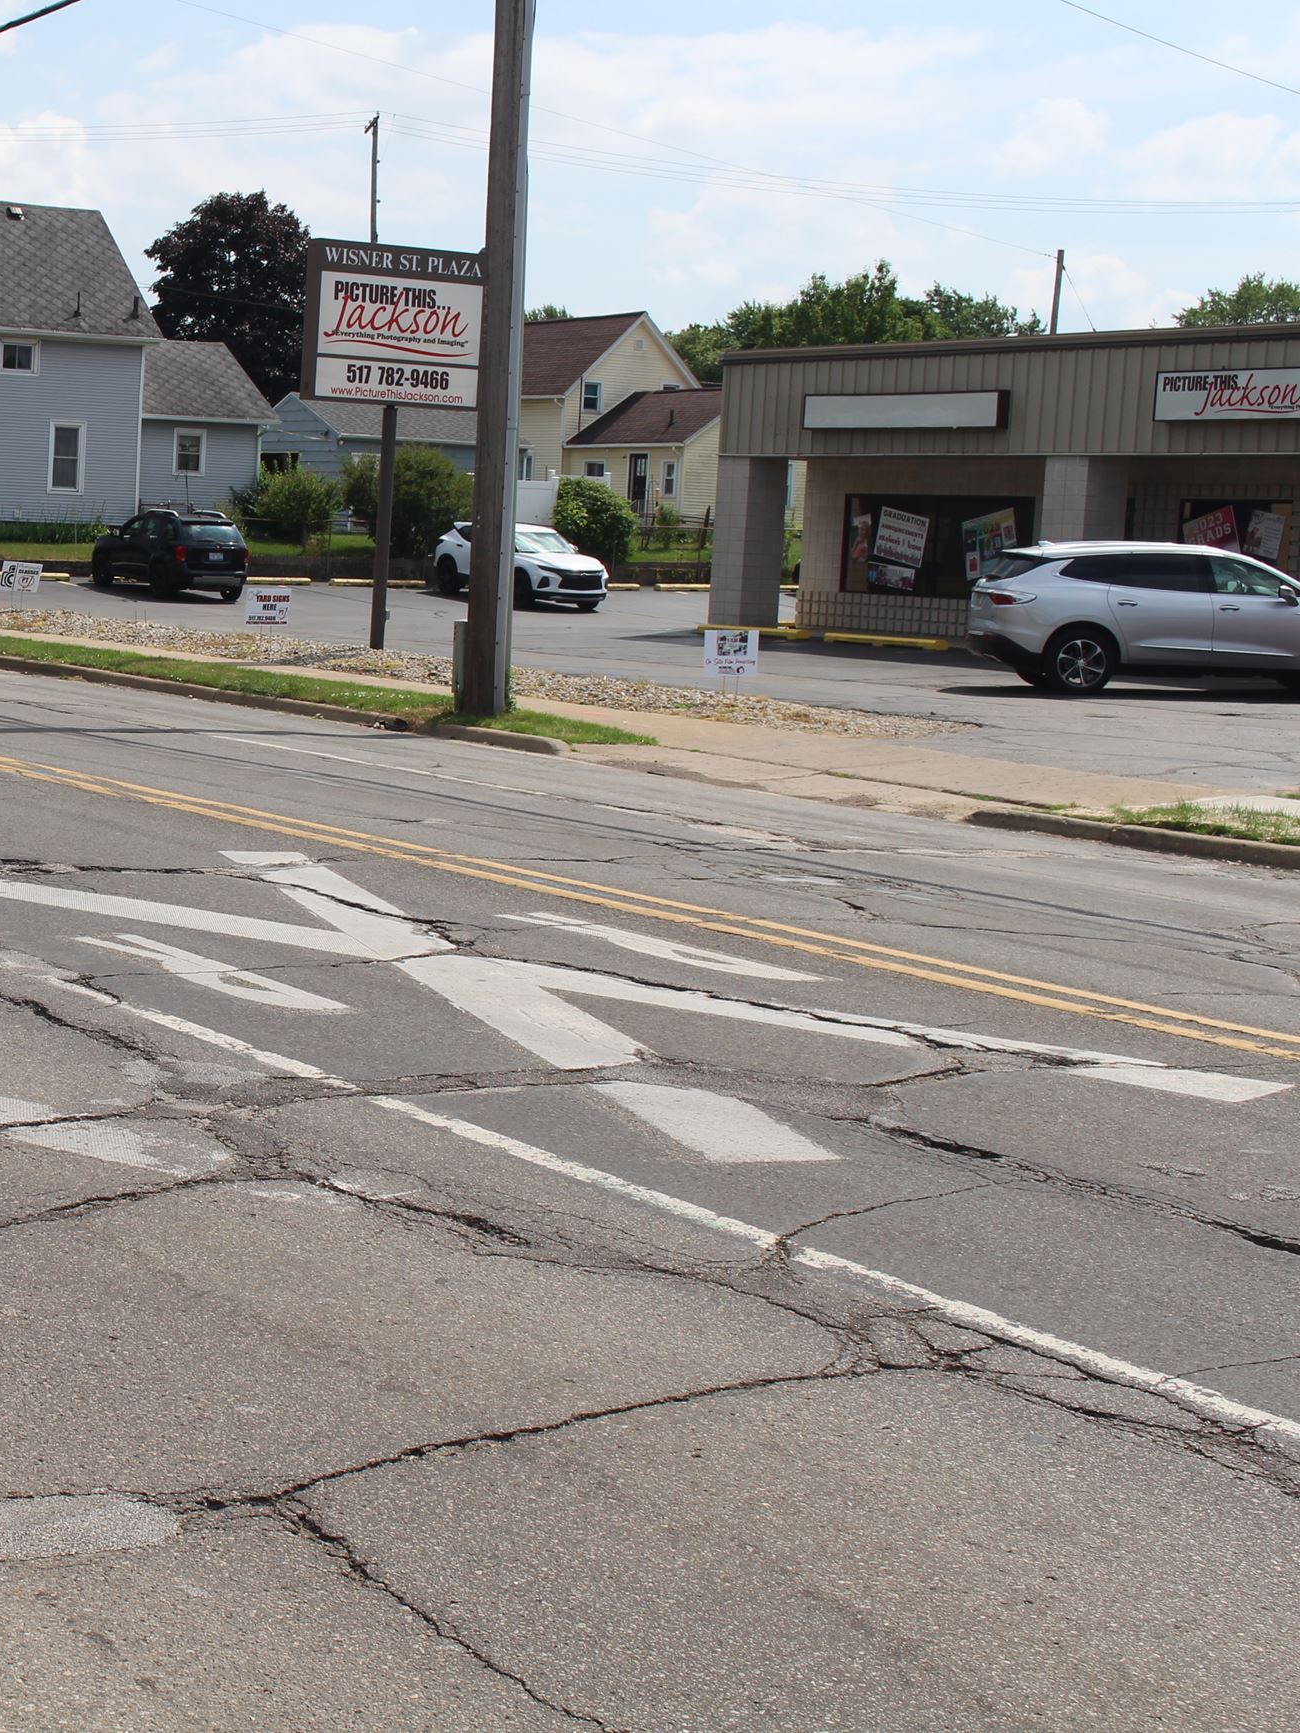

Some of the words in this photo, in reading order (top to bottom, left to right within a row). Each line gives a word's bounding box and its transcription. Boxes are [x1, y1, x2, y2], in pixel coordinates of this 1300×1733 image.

[325, 246, 393, 269] WISNER
[400, 253, 421, 272] ST.
[427, 256, 482, 278] PLAZA
[333, 280, 398, 306] PICTURE
[323, 288, 468, 338] Jackson
[376, 332, 422, 344] Photography
[437, 338, 468, 348] Imaging"
[346, 363, 372, 384] 517
[378, 365, 449, 390] 782-9466
[1162, 375, 1210, 392] PICTURE
[330, 386, 463, 404] www.PictureThisJackson.com
[1194, 372, 1300, 416] Jackson
[883, 510, 927, 528] GRADUATION
